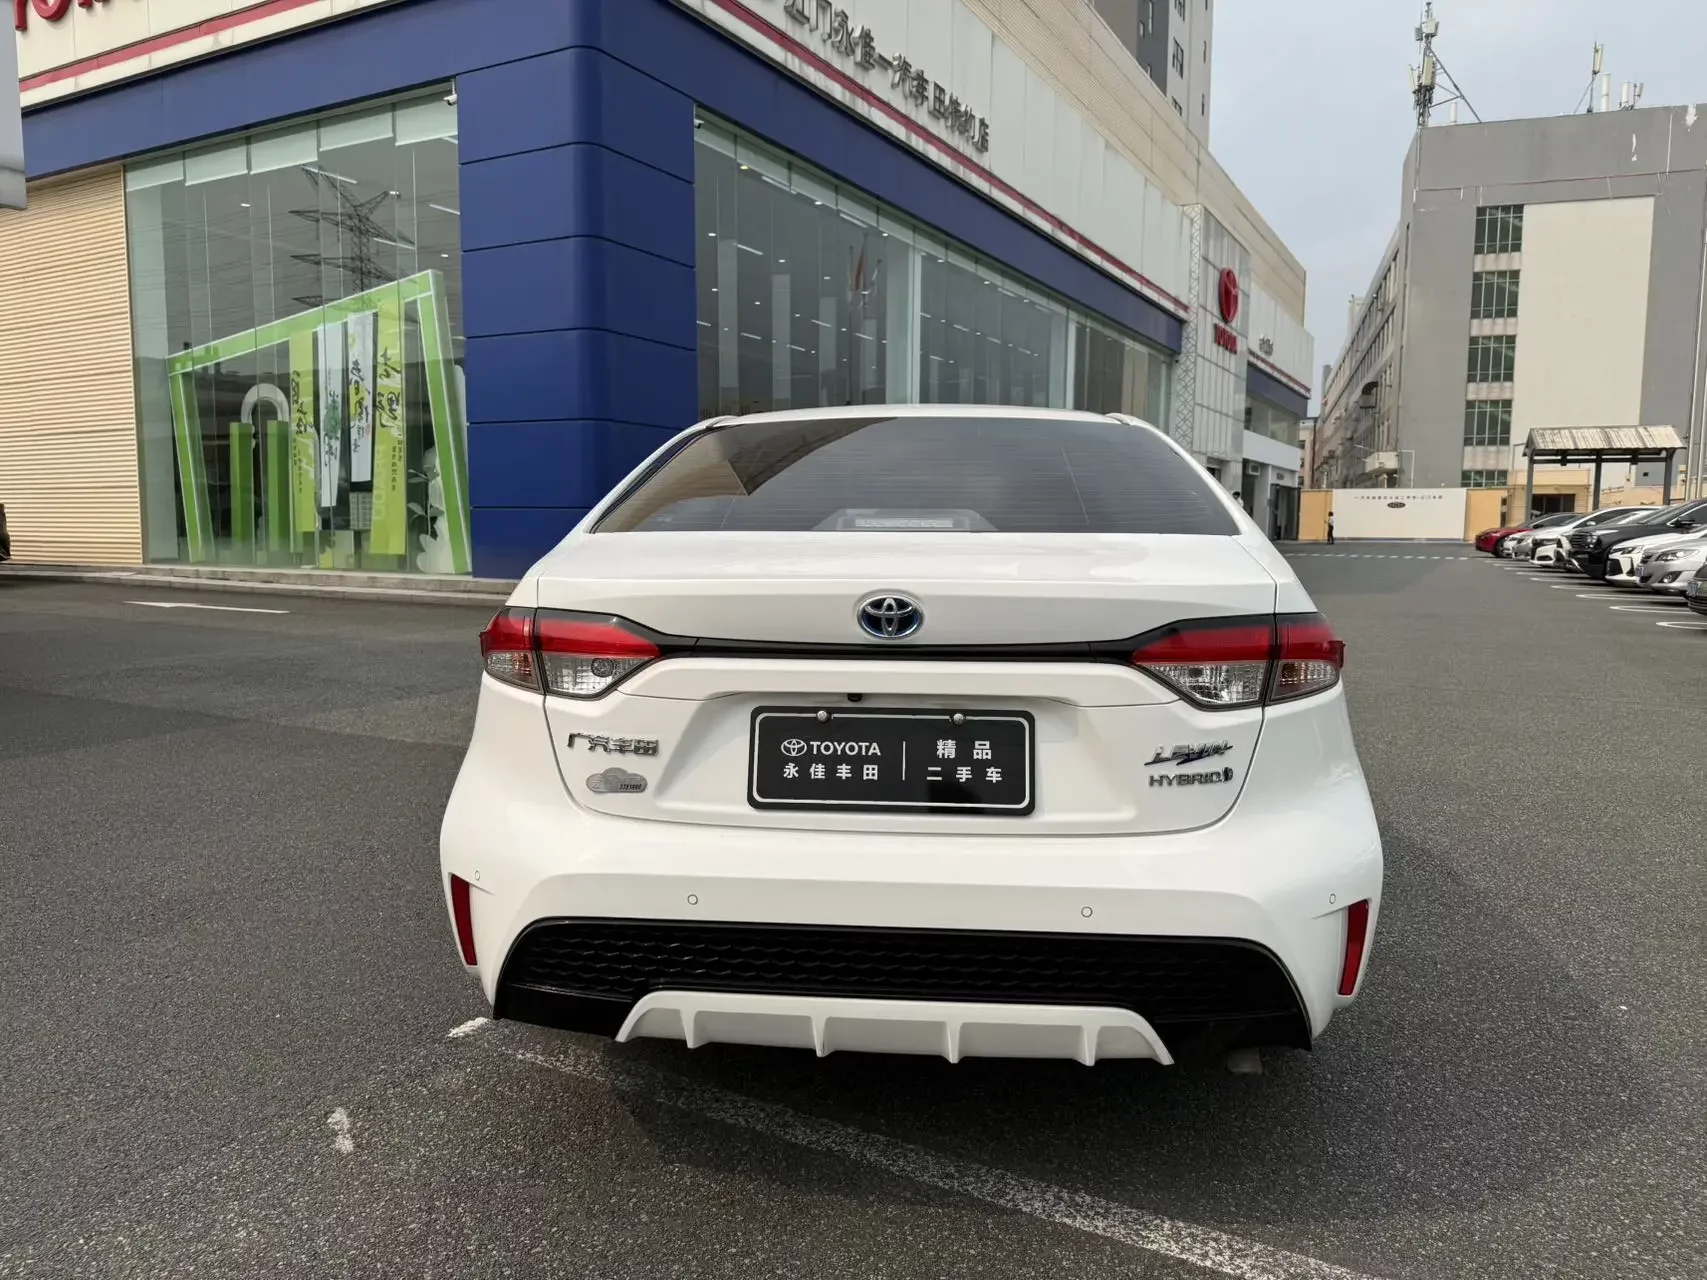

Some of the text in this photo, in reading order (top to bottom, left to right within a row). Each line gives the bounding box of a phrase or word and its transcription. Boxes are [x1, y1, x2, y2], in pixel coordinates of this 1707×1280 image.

[567, 733, 659, 756] 广汽丰田
[809, 741, 881, 756] TOYOTA
[936, 739, 992, 760] 精品
[783, 762, 879, 780] 永佳丰田
[926, 766, 1002, 784] 二手车
[1149, 770, 1222, 787] HYBRID
